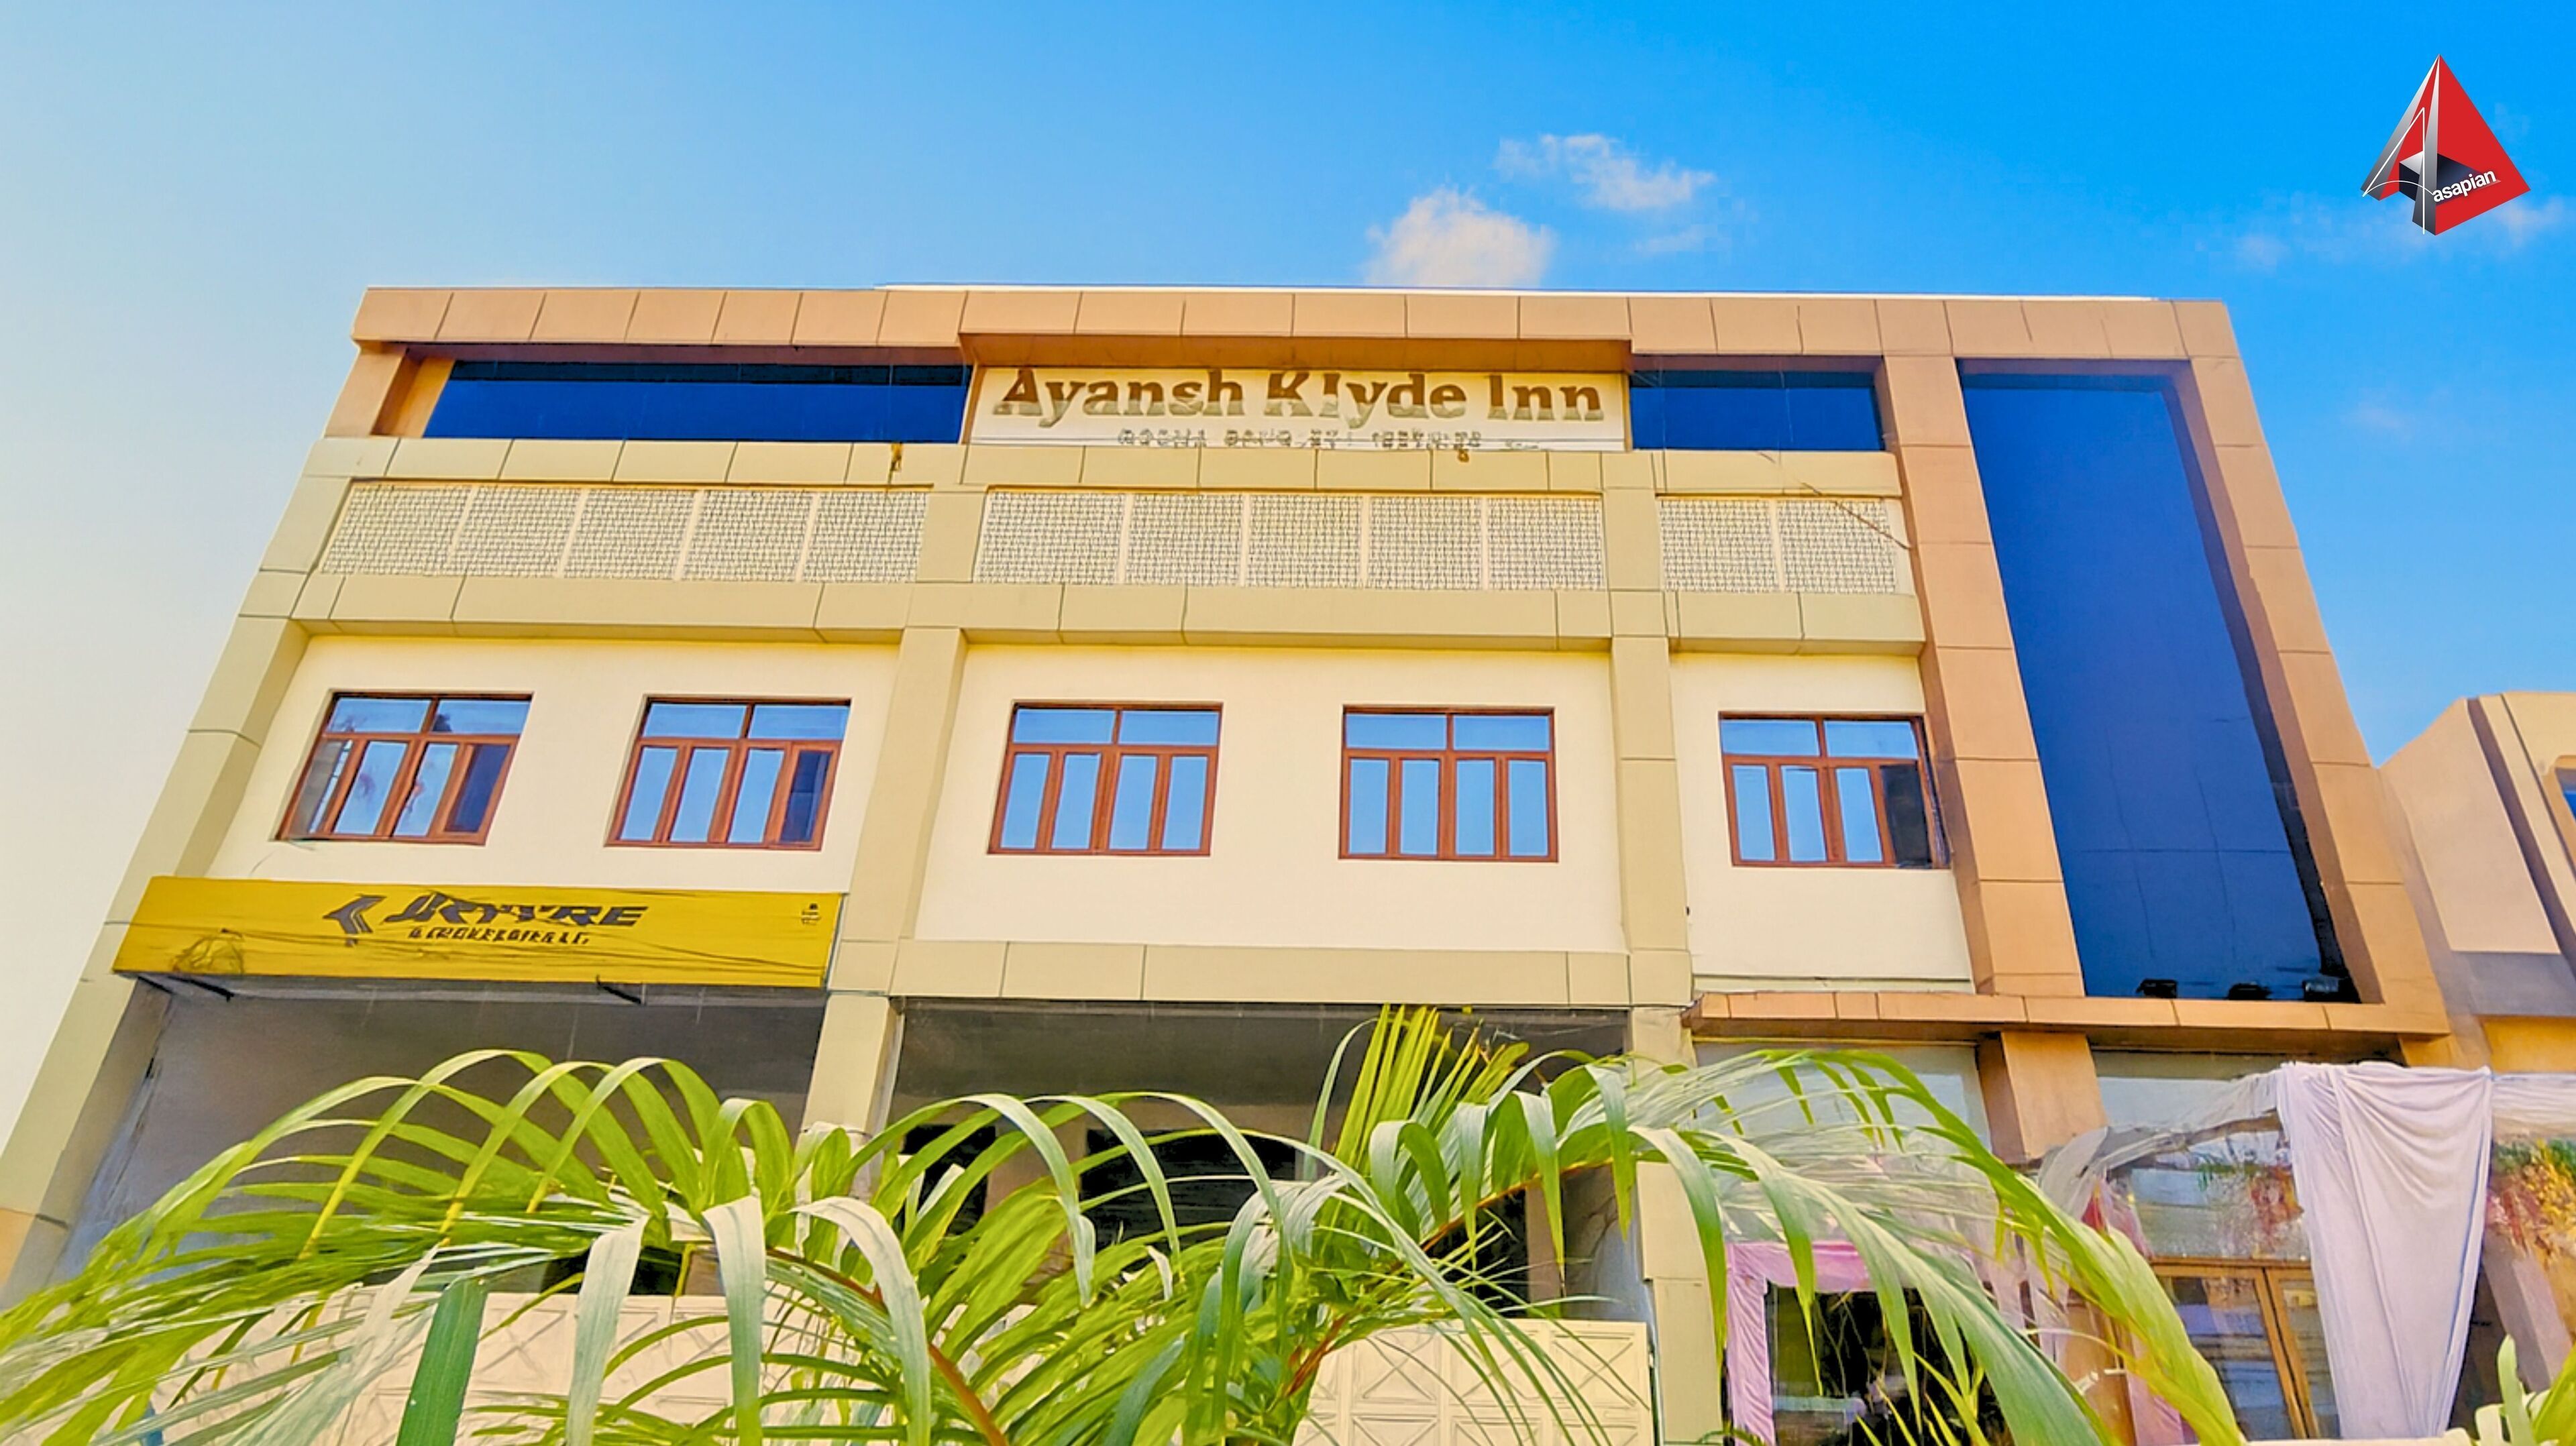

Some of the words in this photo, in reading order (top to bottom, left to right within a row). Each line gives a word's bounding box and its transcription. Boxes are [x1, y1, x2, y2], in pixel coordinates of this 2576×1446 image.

[992, 368, 1246, 428] Ayansh
[1263, 372, 1468, 429] Klyde
[1487, 374, 1605, 421] Inn
